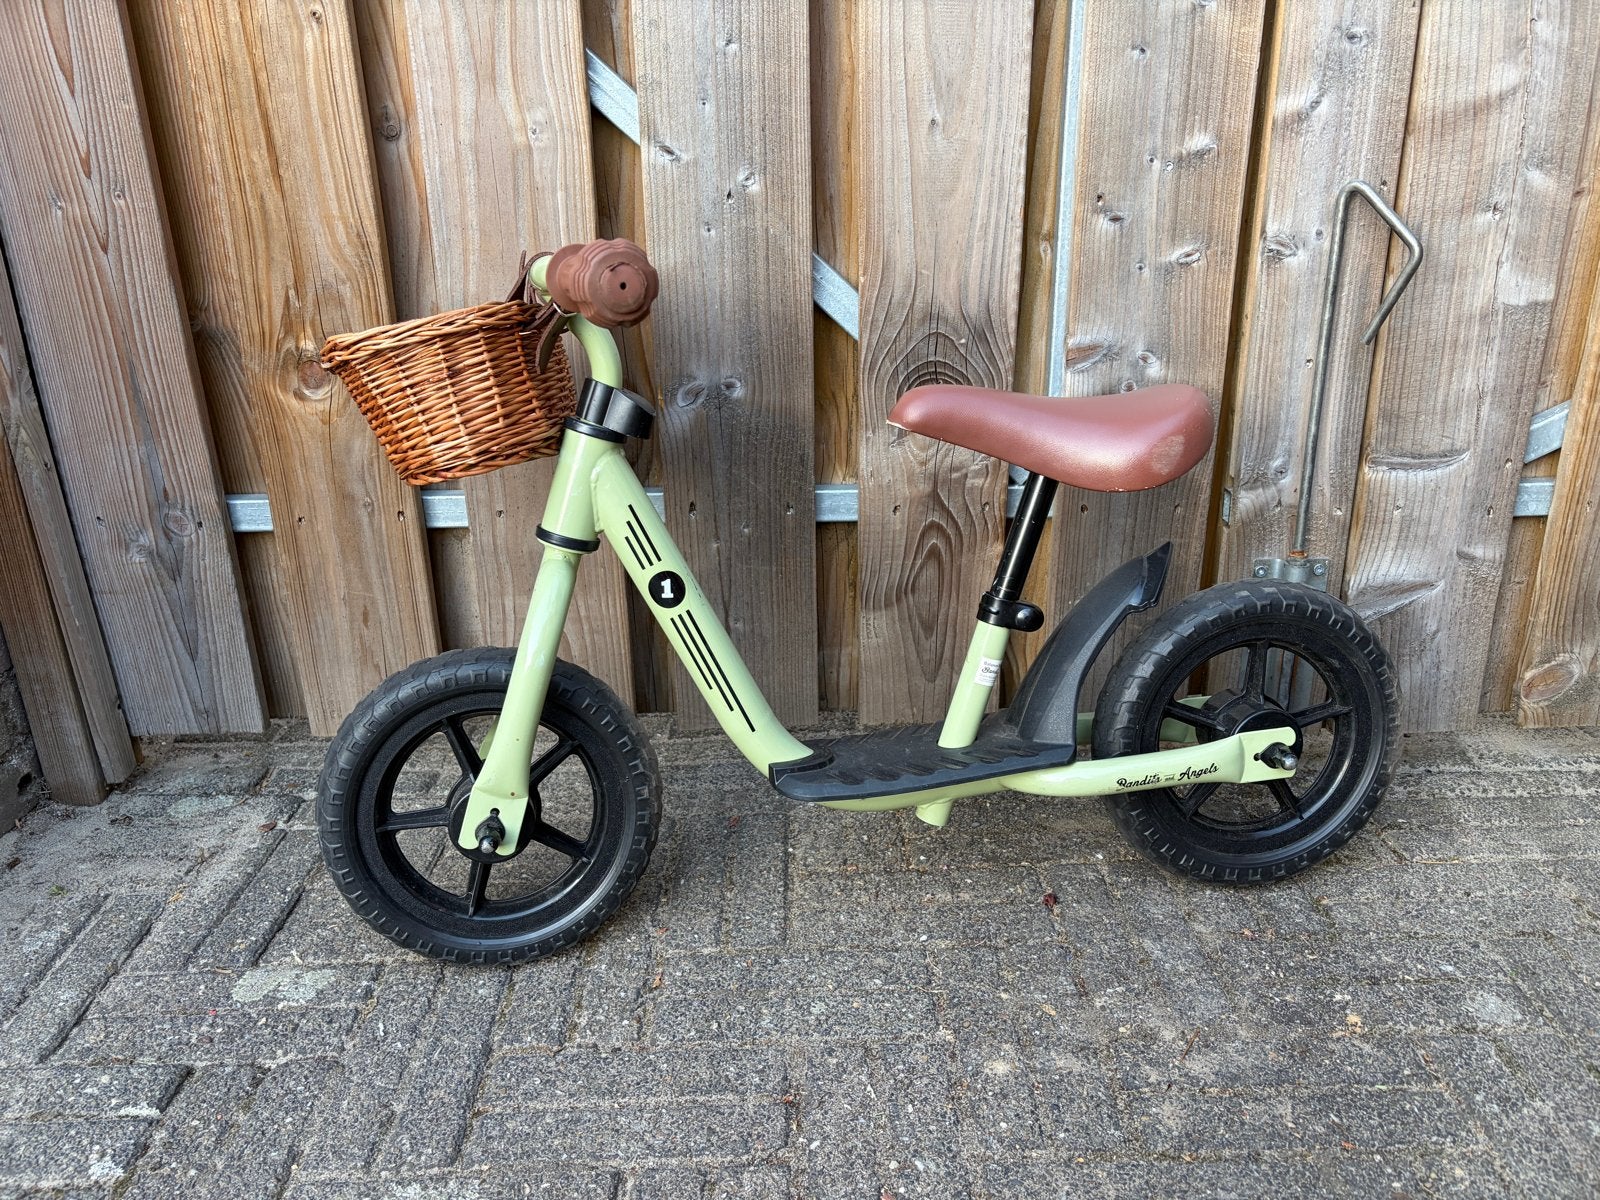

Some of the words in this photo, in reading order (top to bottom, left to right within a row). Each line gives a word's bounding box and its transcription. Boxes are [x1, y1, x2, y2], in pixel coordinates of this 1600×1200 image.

[661, 578, 674, 599] 1
[1116, 772, 1162, 791] Bandits
[1179, 763, 1219, 781] Angels
